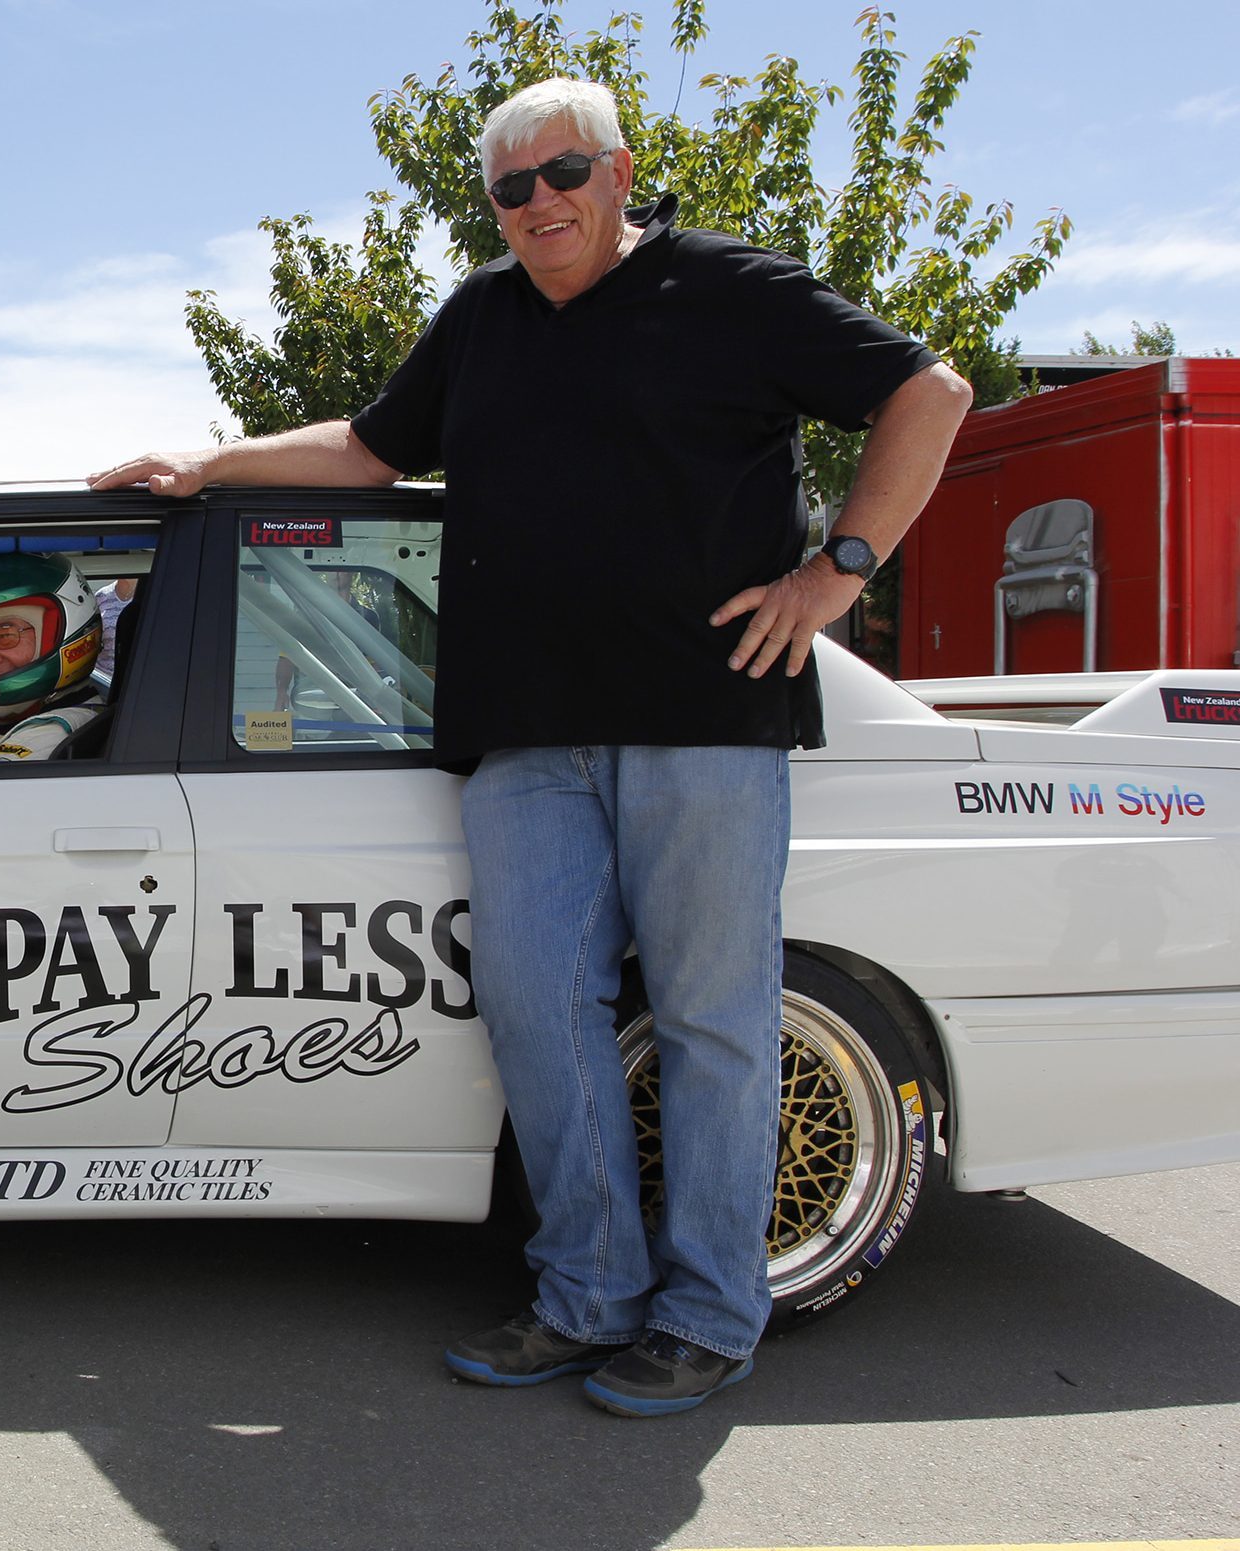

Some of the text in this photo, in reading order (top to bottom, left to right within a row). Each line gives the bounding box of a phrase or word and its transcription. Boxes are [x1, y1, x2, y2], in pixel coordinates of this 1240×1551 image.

[250, 519, 333, 544] trucks
[263, 522, 326, 530] New Zealand
[1173, 695, 1240, 721] truck
[1183, 696, 1204, 704] New
[955, 783, 1206, 825] BMW M Style
[223, 899, 479, 1020] LESS
[1, 992, 421, 1113] Shoes
[83, 1159, 264, 1181] FINE QUALITY
[75, 1181, 273, 1201] CERAMIC TILES
[878, 1138, 925, 1255] MICHELIN
[812, 1287, 848, 1311] MICHELIN
